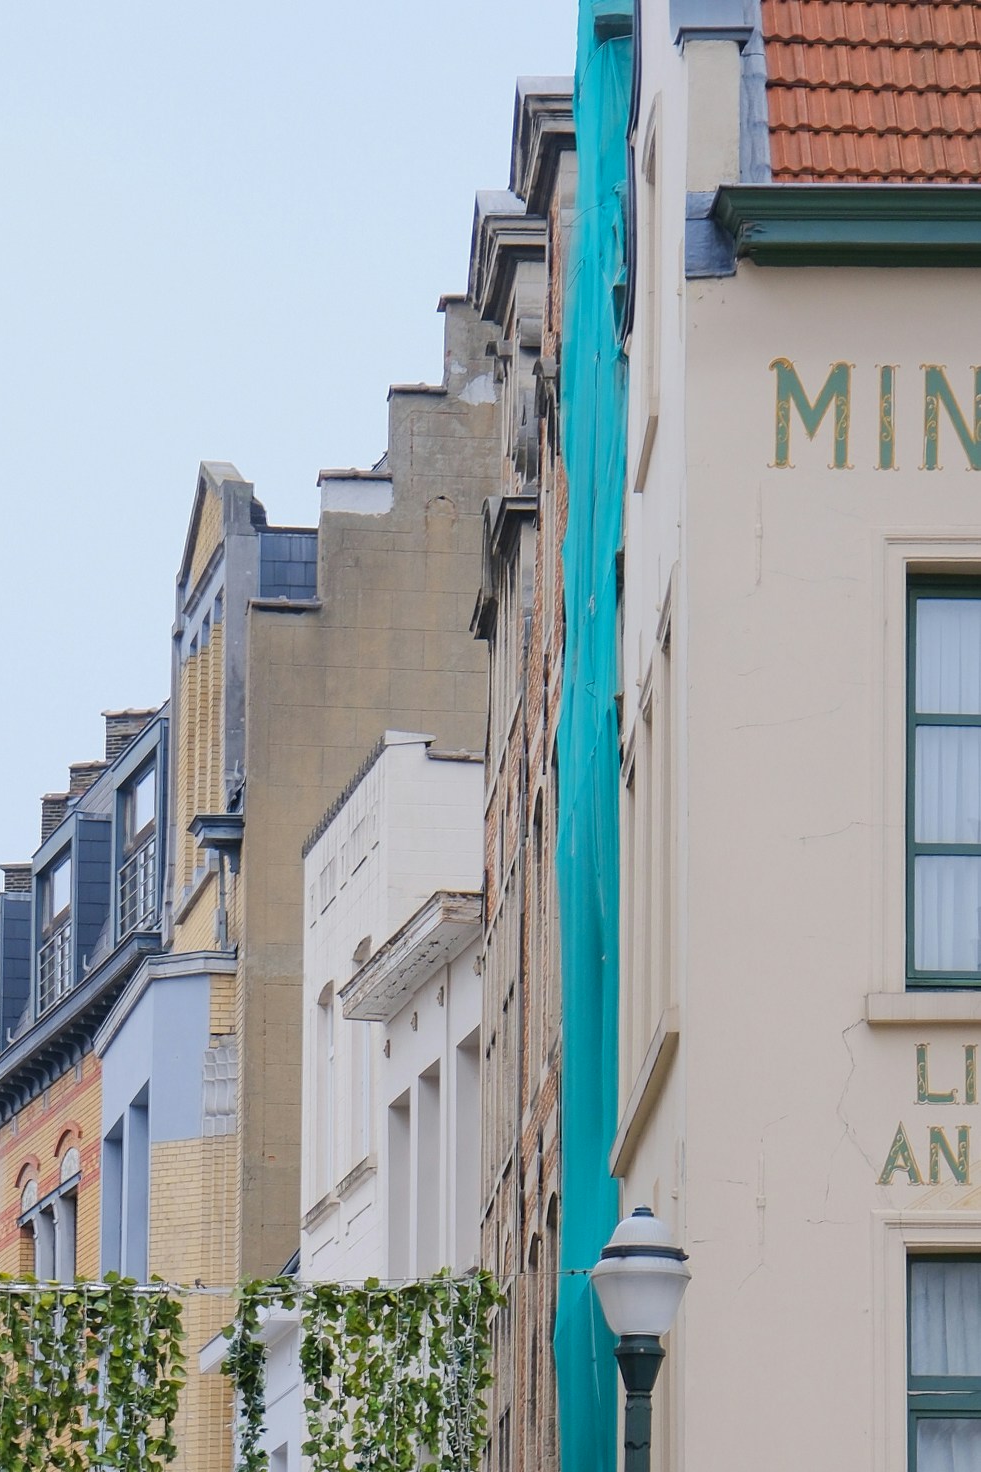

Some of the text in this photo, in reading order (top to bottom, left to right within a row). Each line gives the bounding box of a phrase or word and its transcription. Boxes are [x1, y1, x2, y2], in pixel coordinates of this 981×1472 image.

[767, 357, 981, 472] MIN
[913, 1043, 979, 1105] LI
[875, 1121, 972, 1186] AN
